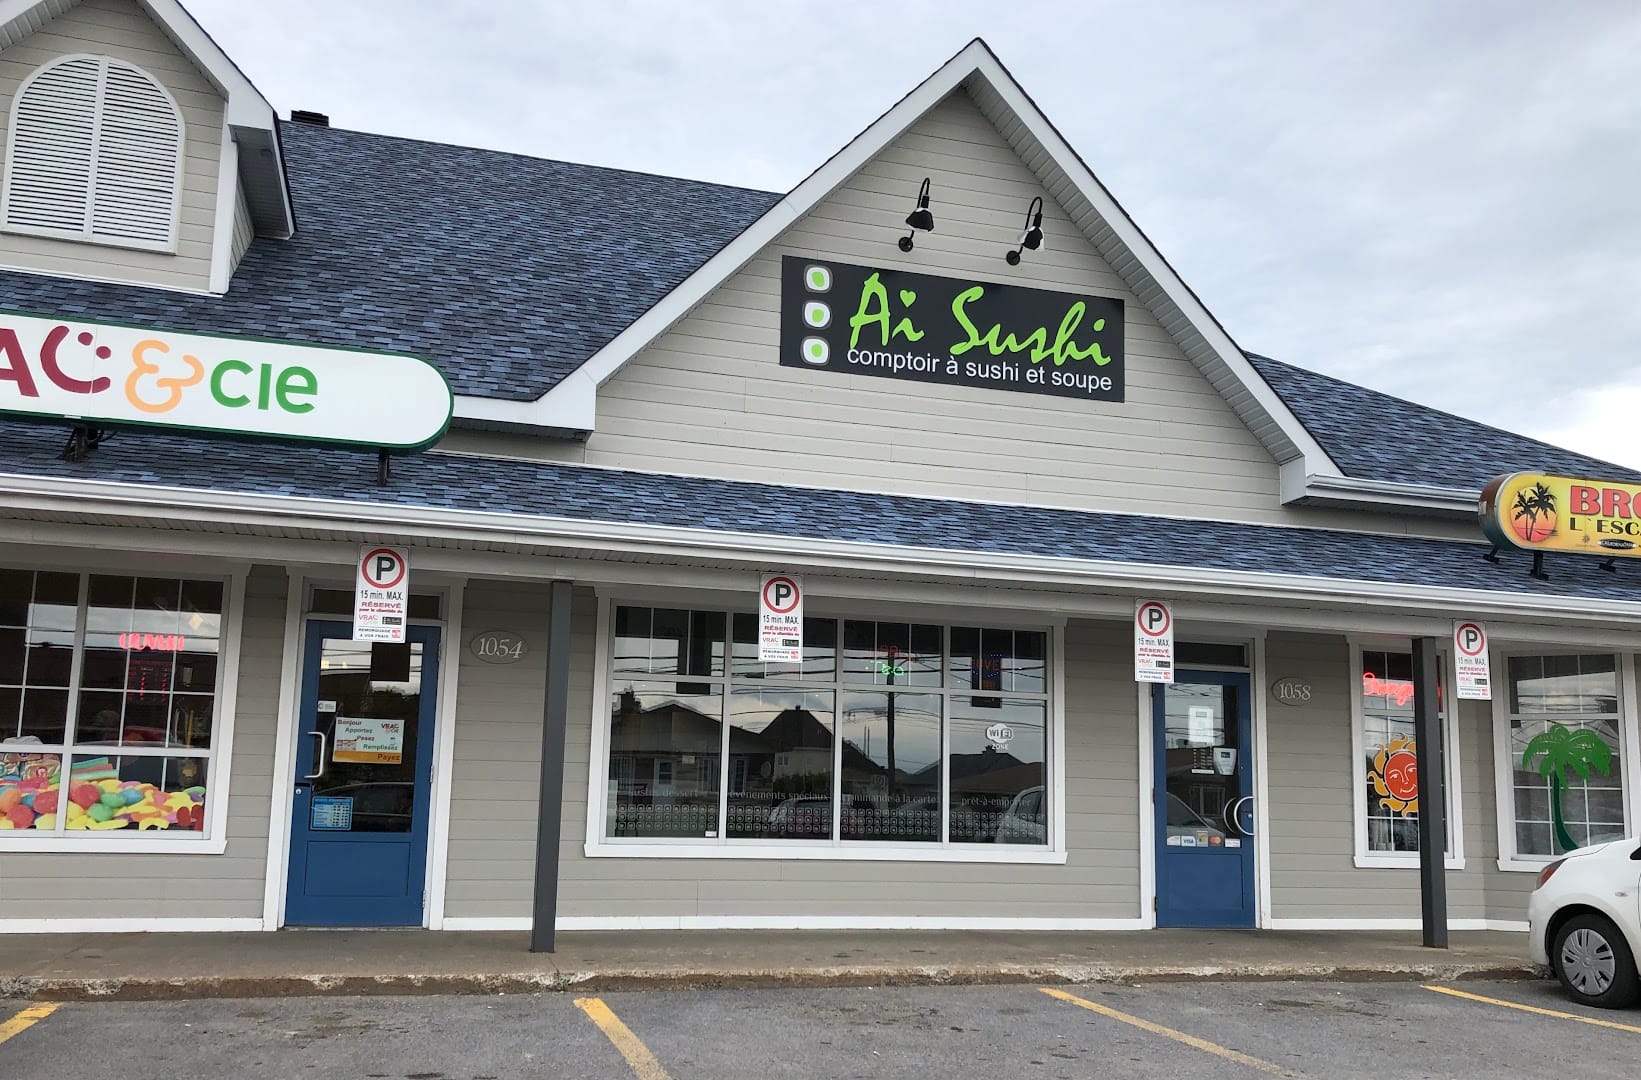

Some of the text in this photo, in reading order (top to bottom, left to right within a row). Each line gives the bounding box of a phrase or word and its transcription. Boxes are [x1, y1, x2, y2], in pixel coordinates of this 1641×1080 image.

[850, 272, 1112, 366] Ai Sushi
[125, 340, 204, 414] &
[847, 349, 1113, 391] comptoir à sushi et soupe
[376, 556, 395, 581] P
[360, 590, 369, 599] 15
[386, 592, 404, 601] MAX.
[776, 583, 792, 606] P
[763, 615, 770, 623] 15
[1148, 608, 1163, 630] P
[479, 637, 523, 658] 1054
[1138, 638, 1145, 646] 15
[1465, 629, 1478, 650] P
[1279, 682, 1311, 701] 1058
[337, 719, 362, 727] Bonjour
[344, 727, 373, 735] Apportez
[992, 743, 1009, 751] ZONE
[377, 753, 400, 762] Payez
